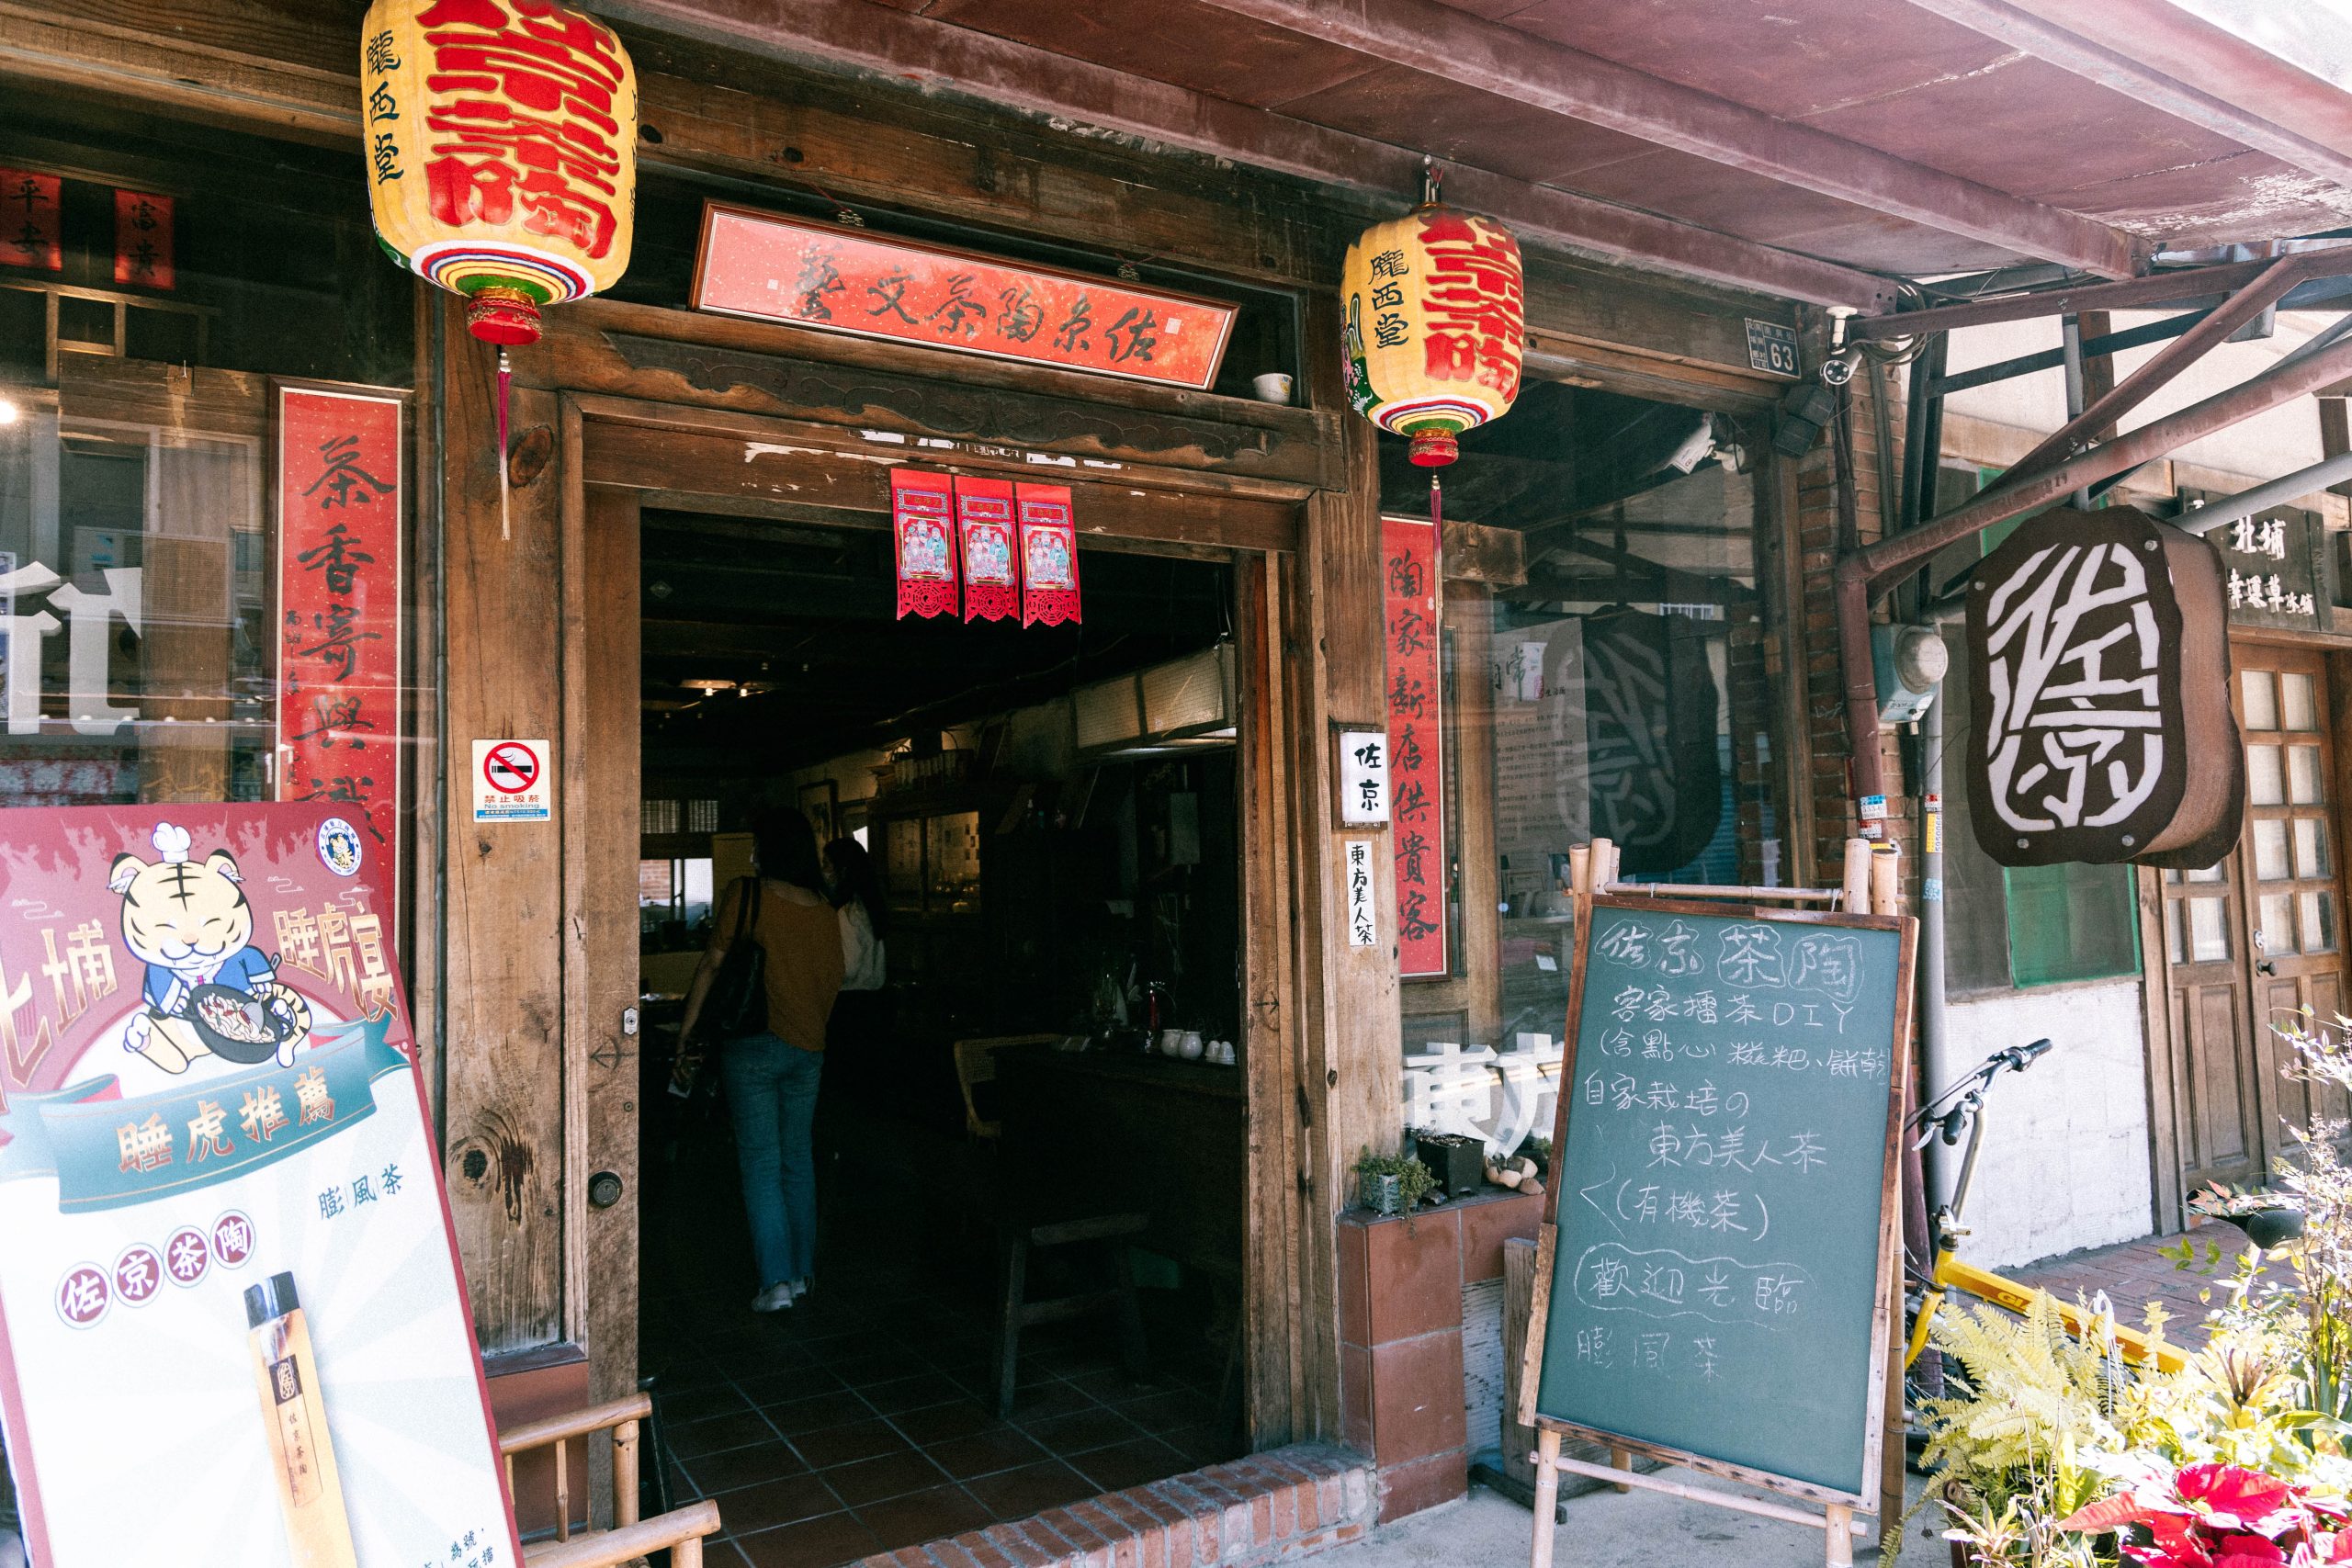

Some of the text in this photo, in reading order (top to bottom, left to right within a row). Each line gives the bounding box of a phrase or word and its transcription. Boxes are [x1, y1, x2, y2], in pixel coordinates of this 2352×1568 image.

[9, 179, 49, 258] 平安
[127, 200, 162, 276] 富貴
[1770, 343, 1793, 371] 63
[484, 795, 540, 803] 禁止吸菸
[1354, 742, 1382, 811] 佐京
[1351, 844, 1374, 945] 東方美人茶
[1600, 923, 1856, 998] 佐京茶陶
[115, 1066, 335, 1175] 睡虎推薦
[1584, 1069, 1749, 1119] 自家栽培の
[1645, 1119, 1827, 1174] 東方美人茶
[318, 1164, 404, 1221] 膨風茶
[61, 1213, 250, 1321] 佐京茶陶
[1589, 1257, 1804, 1314] 歡迎光臨
